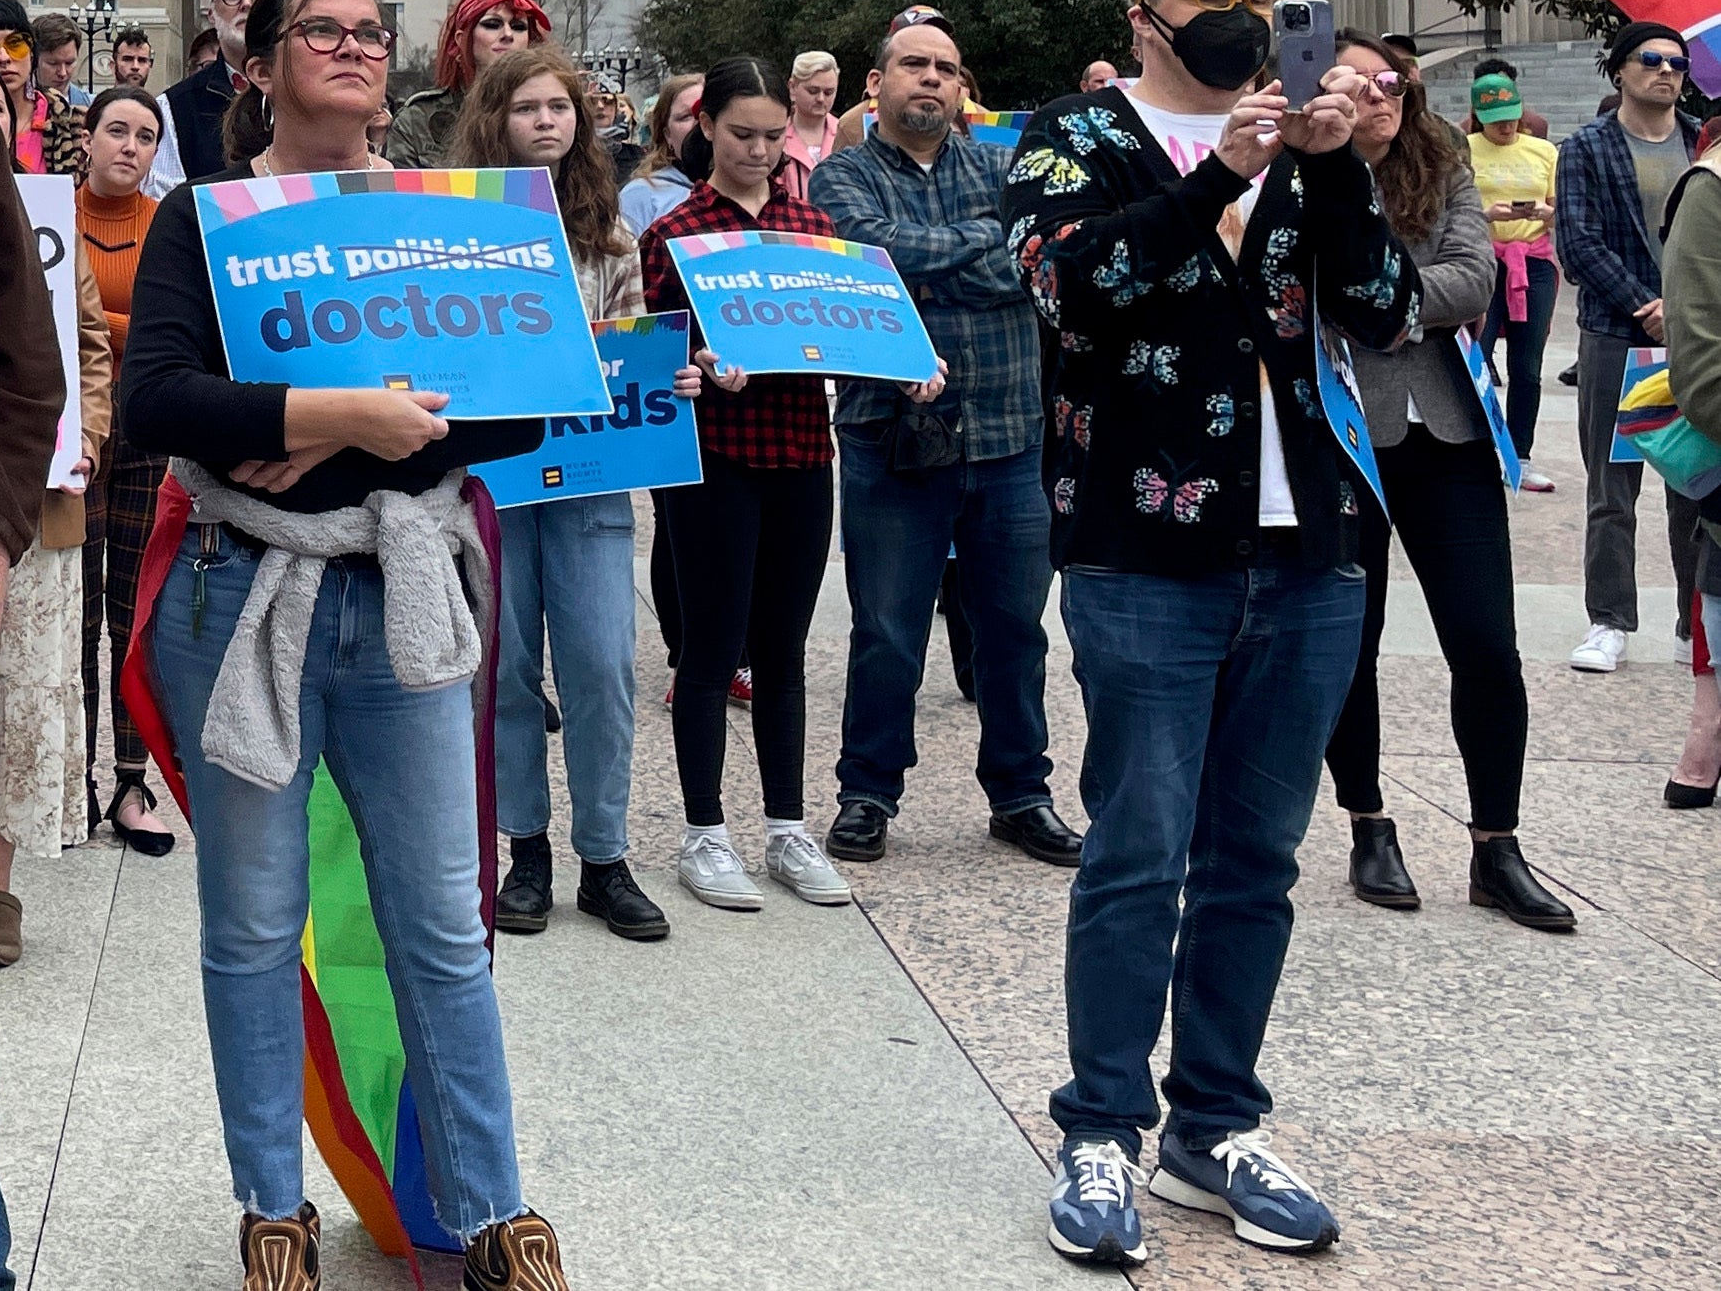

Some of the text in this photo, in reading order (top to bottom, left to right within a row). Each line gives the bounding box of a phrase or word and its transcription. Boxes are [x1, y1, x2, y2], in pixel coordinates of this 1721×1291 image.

[226, 238, 555, 288] trust politicians
[694, 271, 901, 299] trust politicians
[260, 285, 553, 353] doctors
[721, 295, 903, 334] doctors
